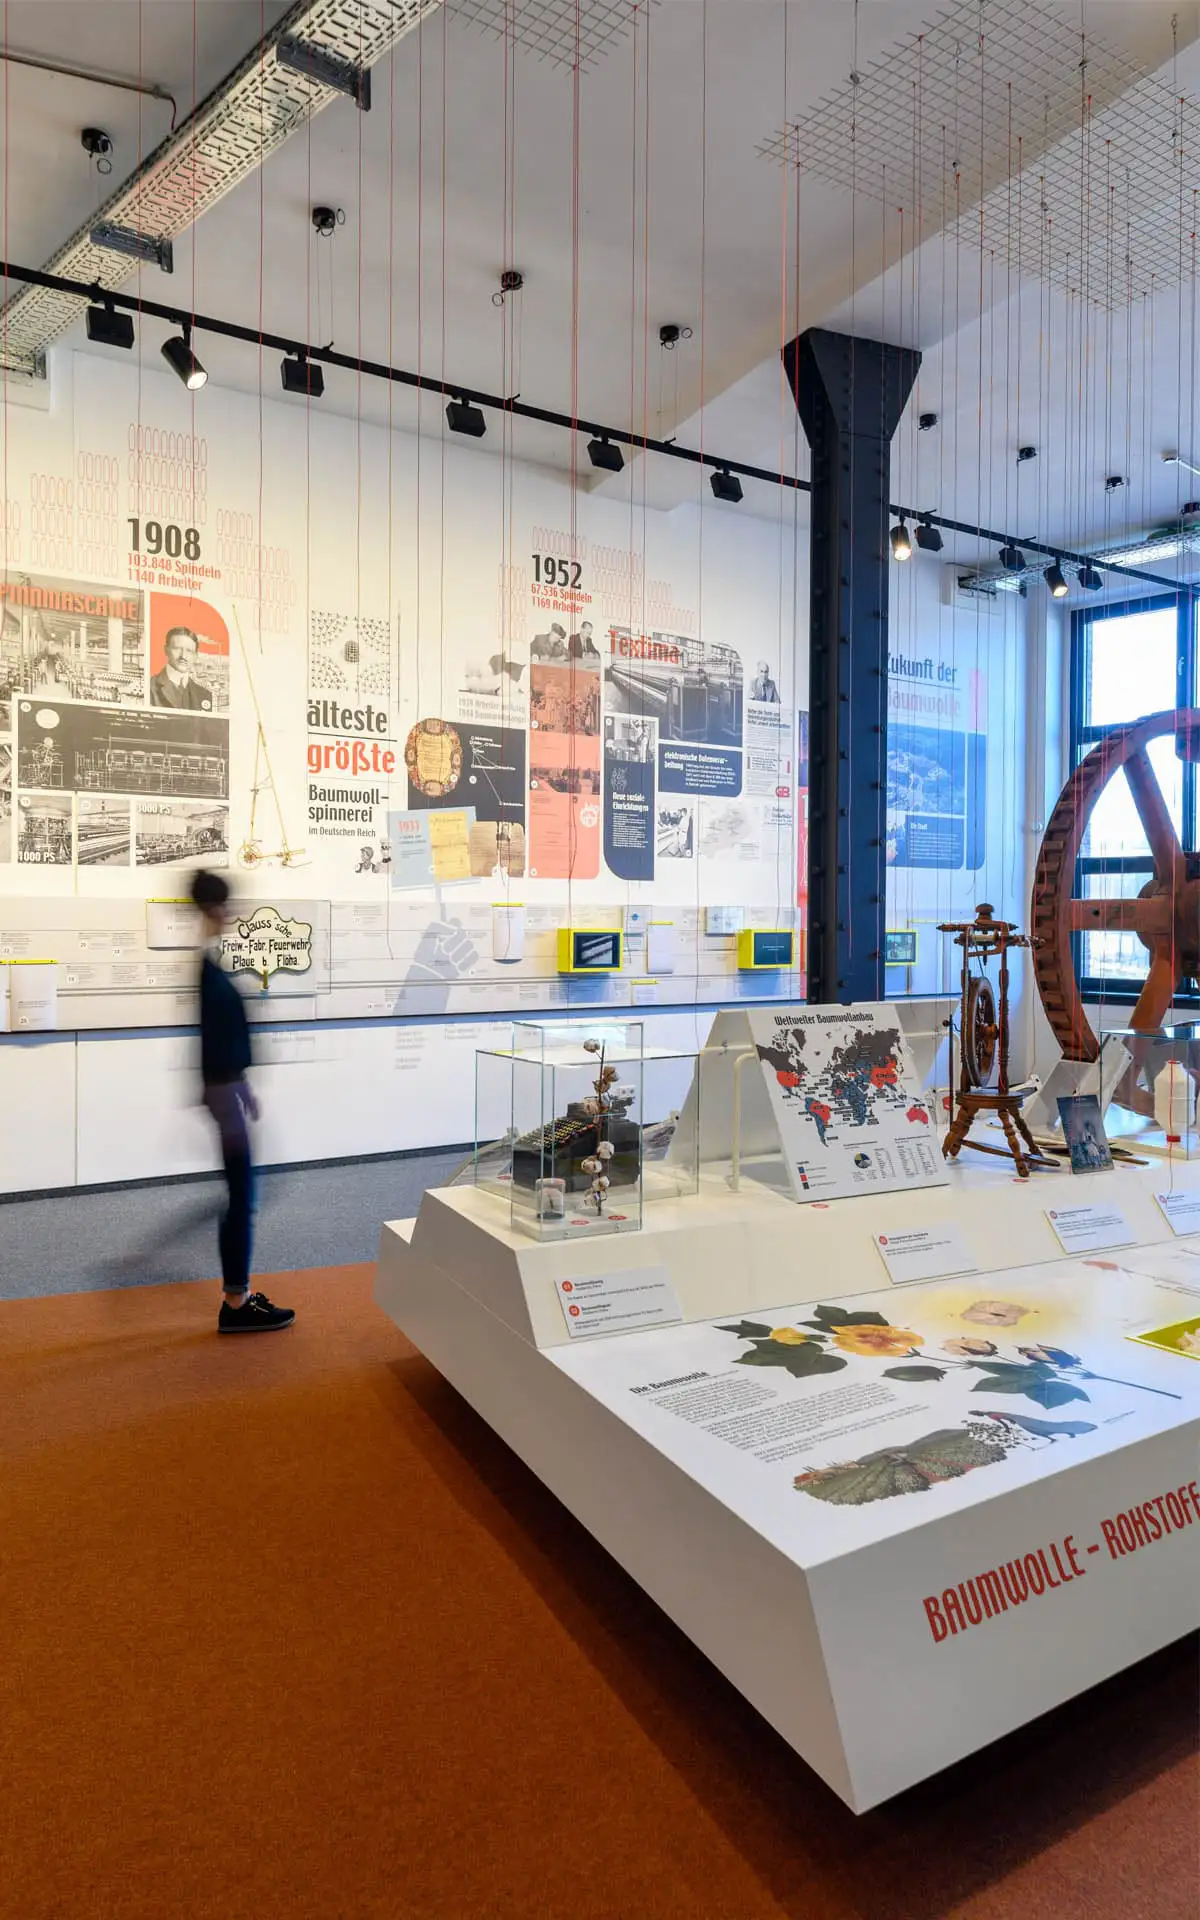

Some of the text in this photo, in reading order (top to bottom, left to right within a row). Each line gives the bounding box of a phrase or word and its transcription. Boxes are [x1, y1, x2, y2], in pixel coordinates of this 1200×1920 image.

[127, 517, 201, 561] 1908
[175, 562, 222, 580] Spindeln
[531, 554, 583, 590] 1952
[157, 573, 204, 590] Arbeiter
[608, 630, 680, 664] Textima
[937, 662, 958, 682] der
[307, 700, 388, 733] älteste
[307, 740, 396, 776] größte
[309, 784, 389, 805] Baumwoll-
[308, 806, 373, 823] spinnerei
[308, 827, 376, 838] im Deutschen Reich
[43, 852, 56, 863] PS
[268, 938, 309, 954] Feuerwehr
[232, 955, 256, 970] Plaue
[774, 1012, 874, 1026] Weltweiter Baumwollanbau
[629, 1371, 711, 1394] Die Baumwolle
[923, 1535, 1085, 1643] BAUMWOLLE
[1100, 1481, 1200, 1560] ROHSTOFF
